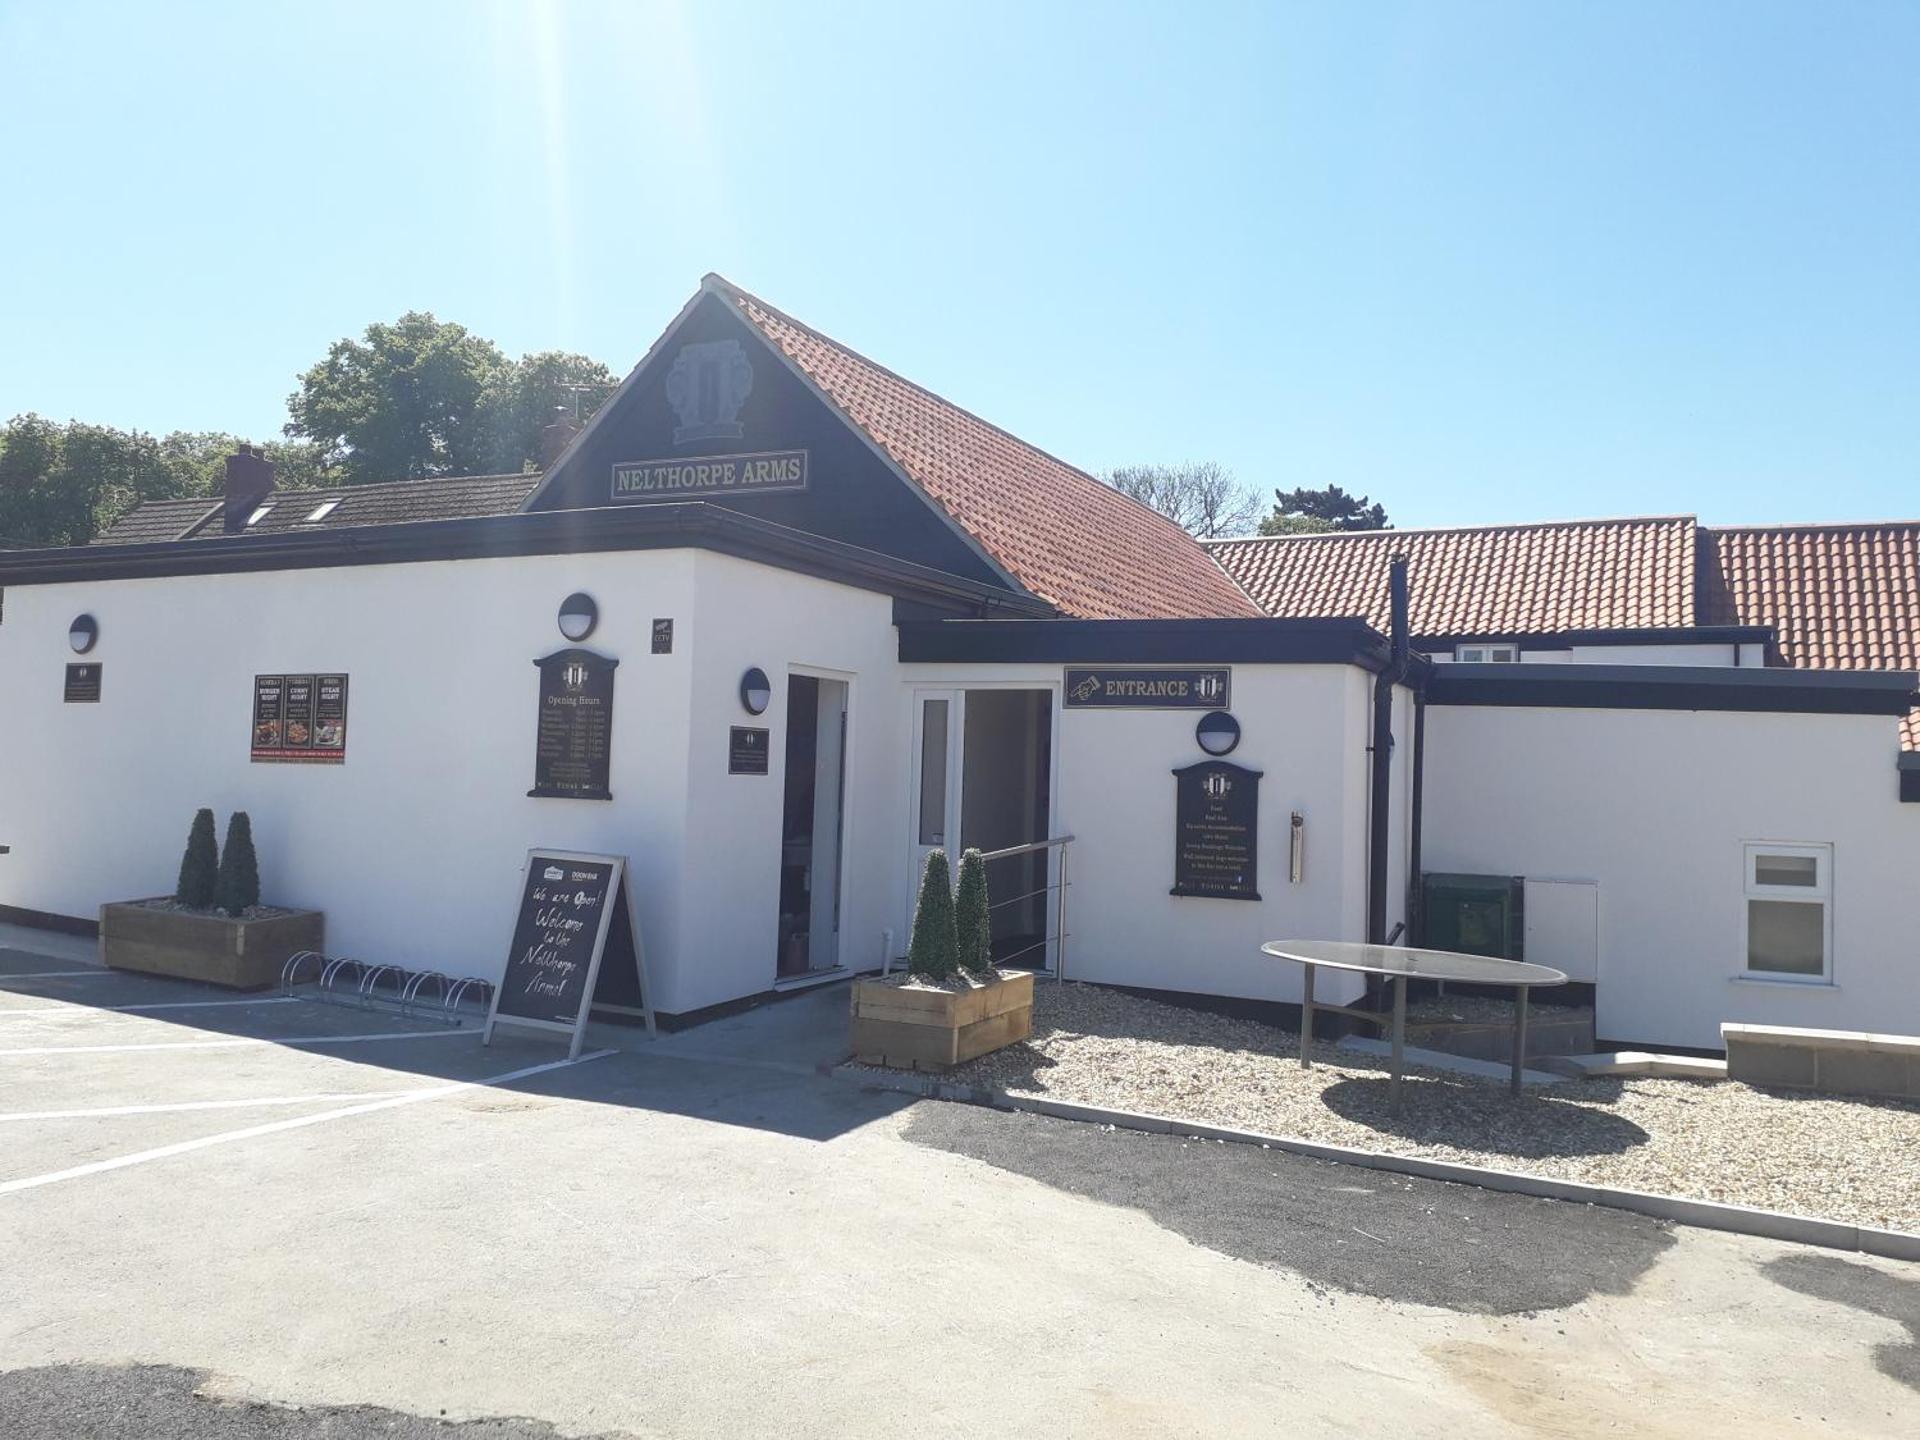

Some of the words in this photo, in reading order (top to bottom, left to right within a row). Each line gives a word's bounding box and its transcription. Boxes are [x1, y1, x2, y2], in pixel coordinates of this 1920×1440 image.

[617, 463, 736, 491] NELTHORPE
[742, 458, 801, 483] ARMS
[1105, 680, 1189, 696] ENTRANCE
[548, 696, 577, 706] Opening
[579, 696, 601, 704] Hours
[533, 887, 547, 900] We
[552, 894, 570, 903] are
[574, 890, 602, 909] Open!
[535, 907, 583, 932] Welcome
[544, 930, 555, 943] to
[556, 931, 571, 946] the
[520, 944, 577, 976] Nelthorpe
